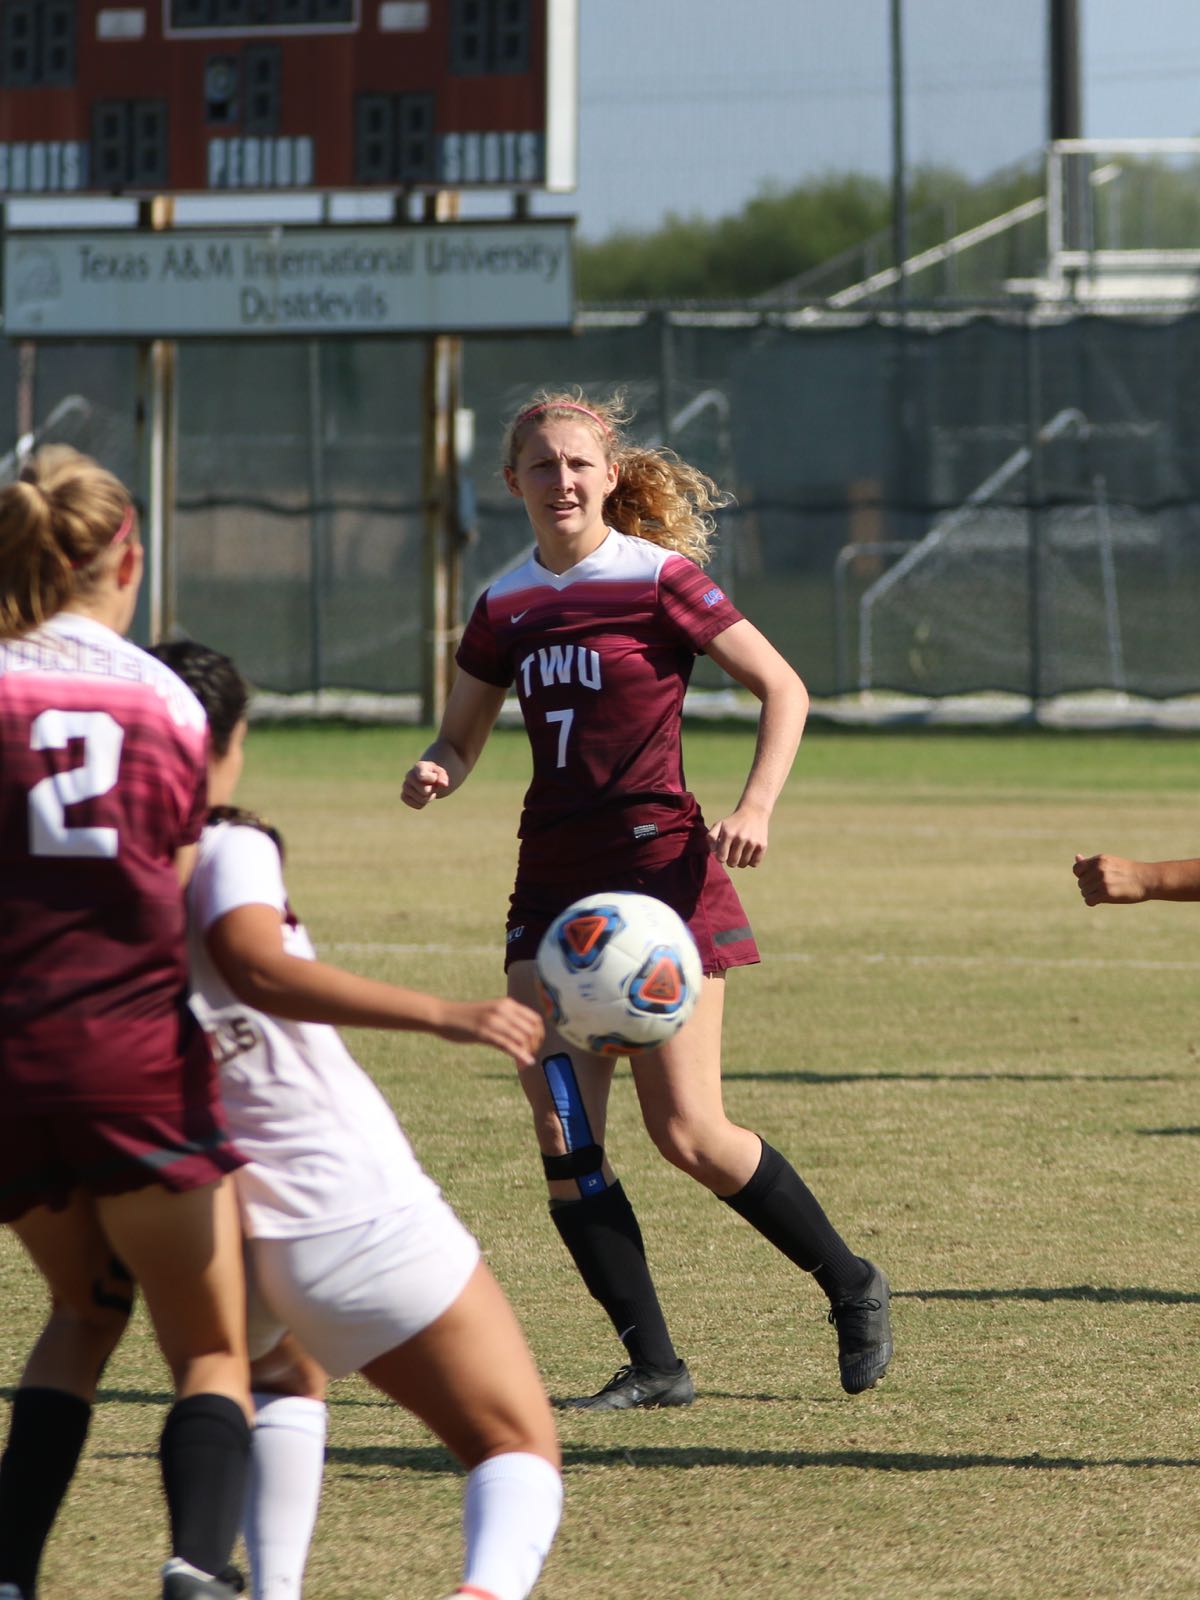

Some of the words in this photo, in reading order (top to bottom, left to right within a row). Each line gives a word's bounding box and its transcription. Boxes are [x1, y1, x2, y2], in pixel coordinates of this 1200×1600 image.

[78, 244, 149, 281] Texas
[160, 243, 234, 281] A&M
[244, 239, 413, 277] International
[424, 237, 561, 282] University
[240, 284, 388, 324] Dustdevils
[520, 644, 603, 698] TWU
[545, 708, 575, 768] 7
[28, 708, 124, 858] 2
[506, 925, 525, 944] WU
